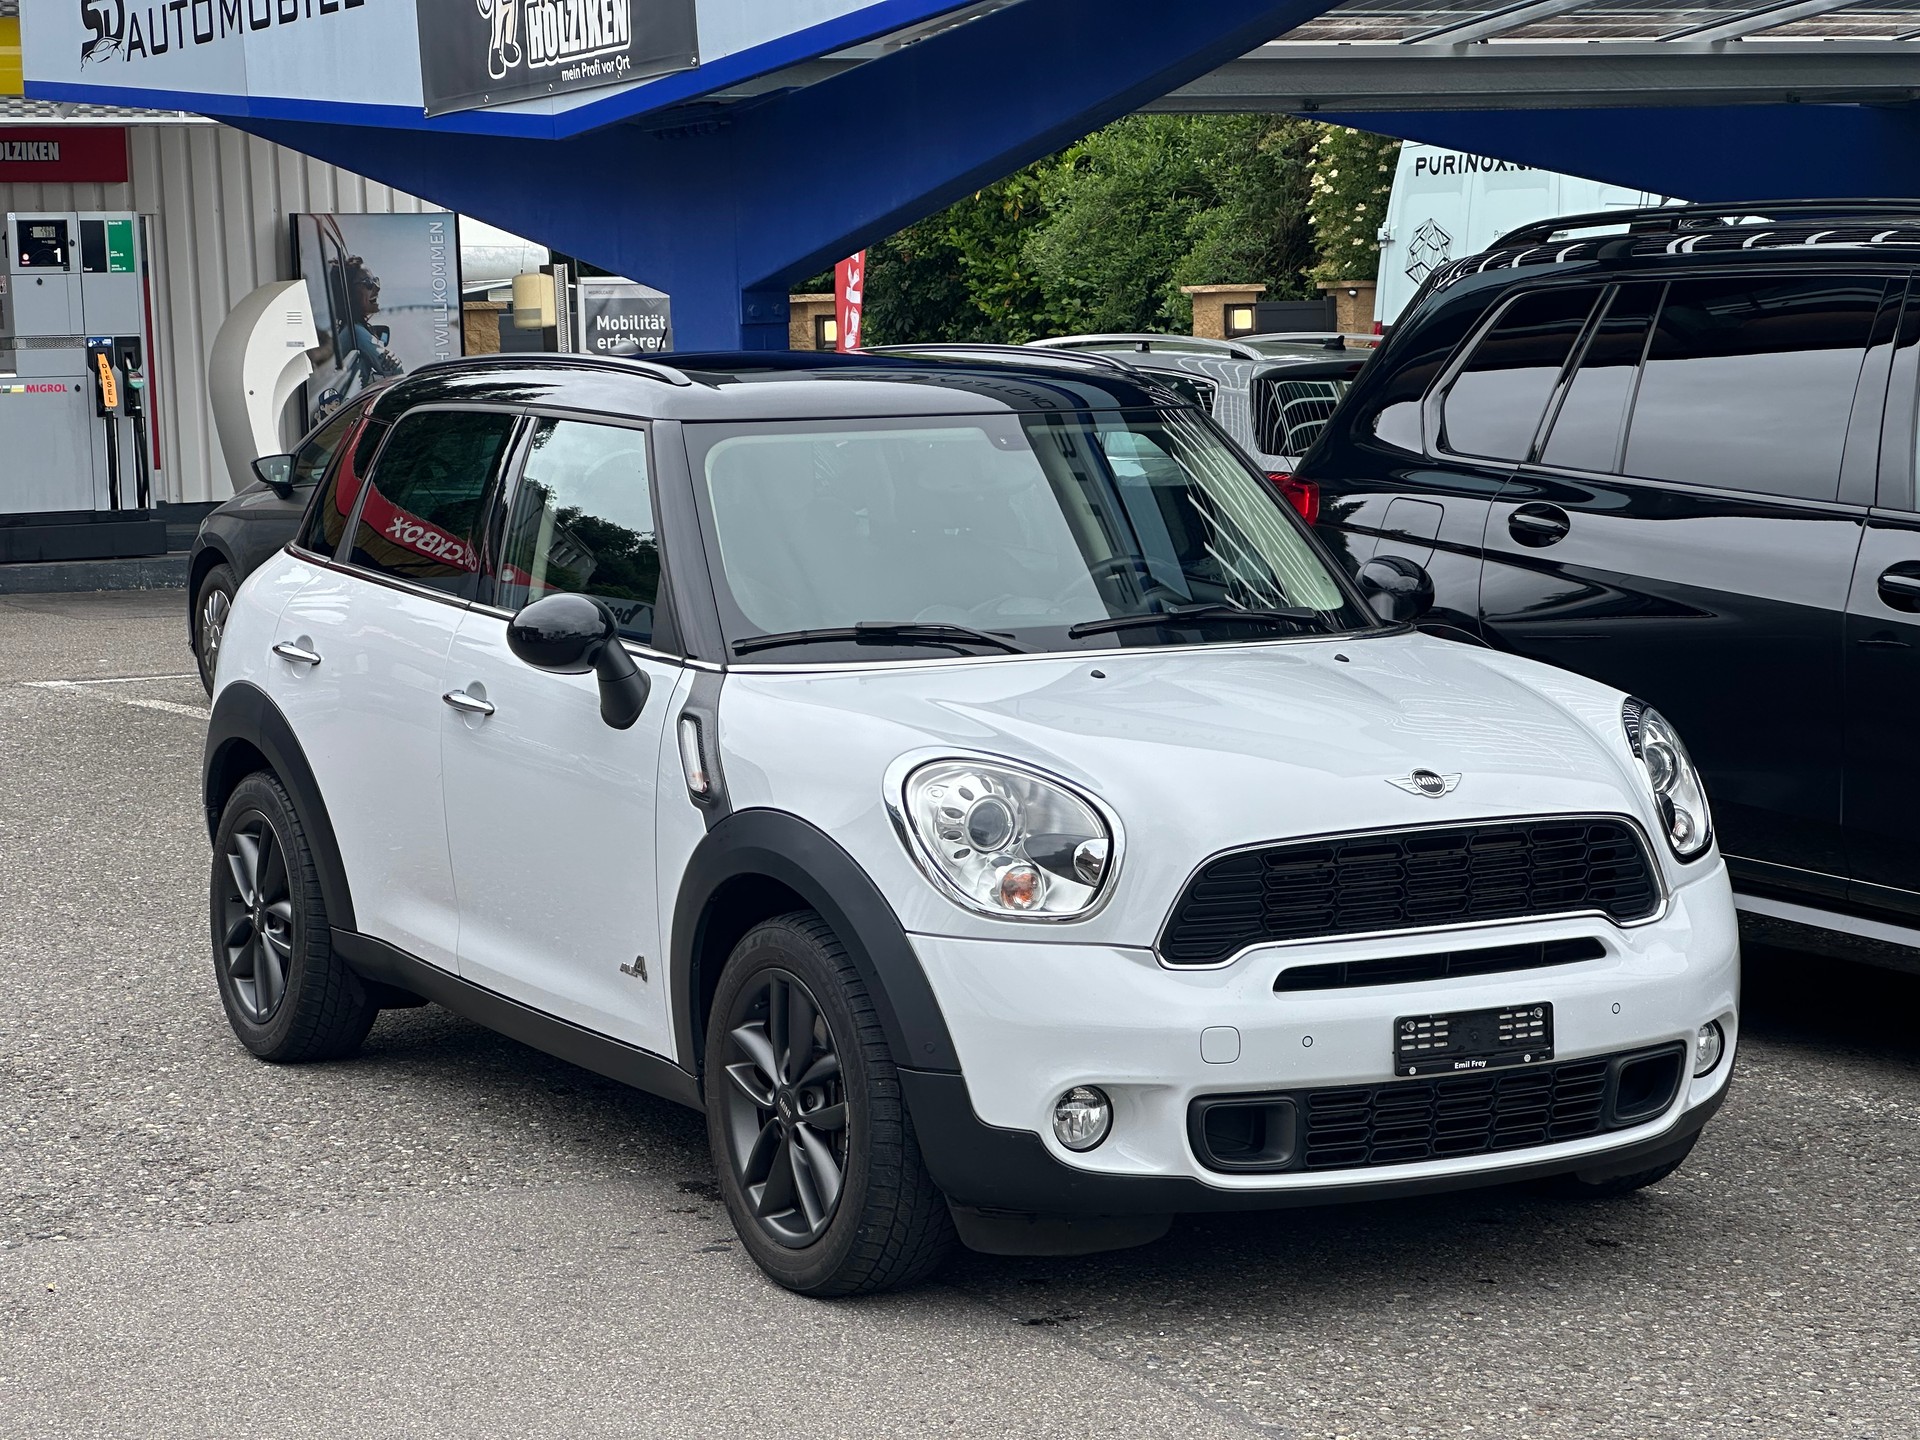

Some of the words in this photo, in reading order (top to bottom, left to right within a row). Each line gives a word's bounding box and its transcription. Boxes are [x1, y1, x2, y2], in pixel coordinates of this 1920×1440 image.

[528, 0, 628, 60] HOLZIKEN
[561, 64, 581, 81] mein
[581, 59, 600, 78] Profi
[601, 61, 614, 74] vor
[616, 55, 630, 71] Ort
[54, 248, 61, 263] 1
[429, 222, 449, 347] WILLKOMMEN
[596, 314, 666, 331] Mobilität
[597, 334, 666, 349] erfhren
[26, 384, 67, 393] MIGROL
[101, 363, 113, 403] DIESEL
[1416, 776, 1442, 786] MINI
[1455, 1060, 1470, 1069] Emil
[1471, 1060, 1486, 1068] Frey
